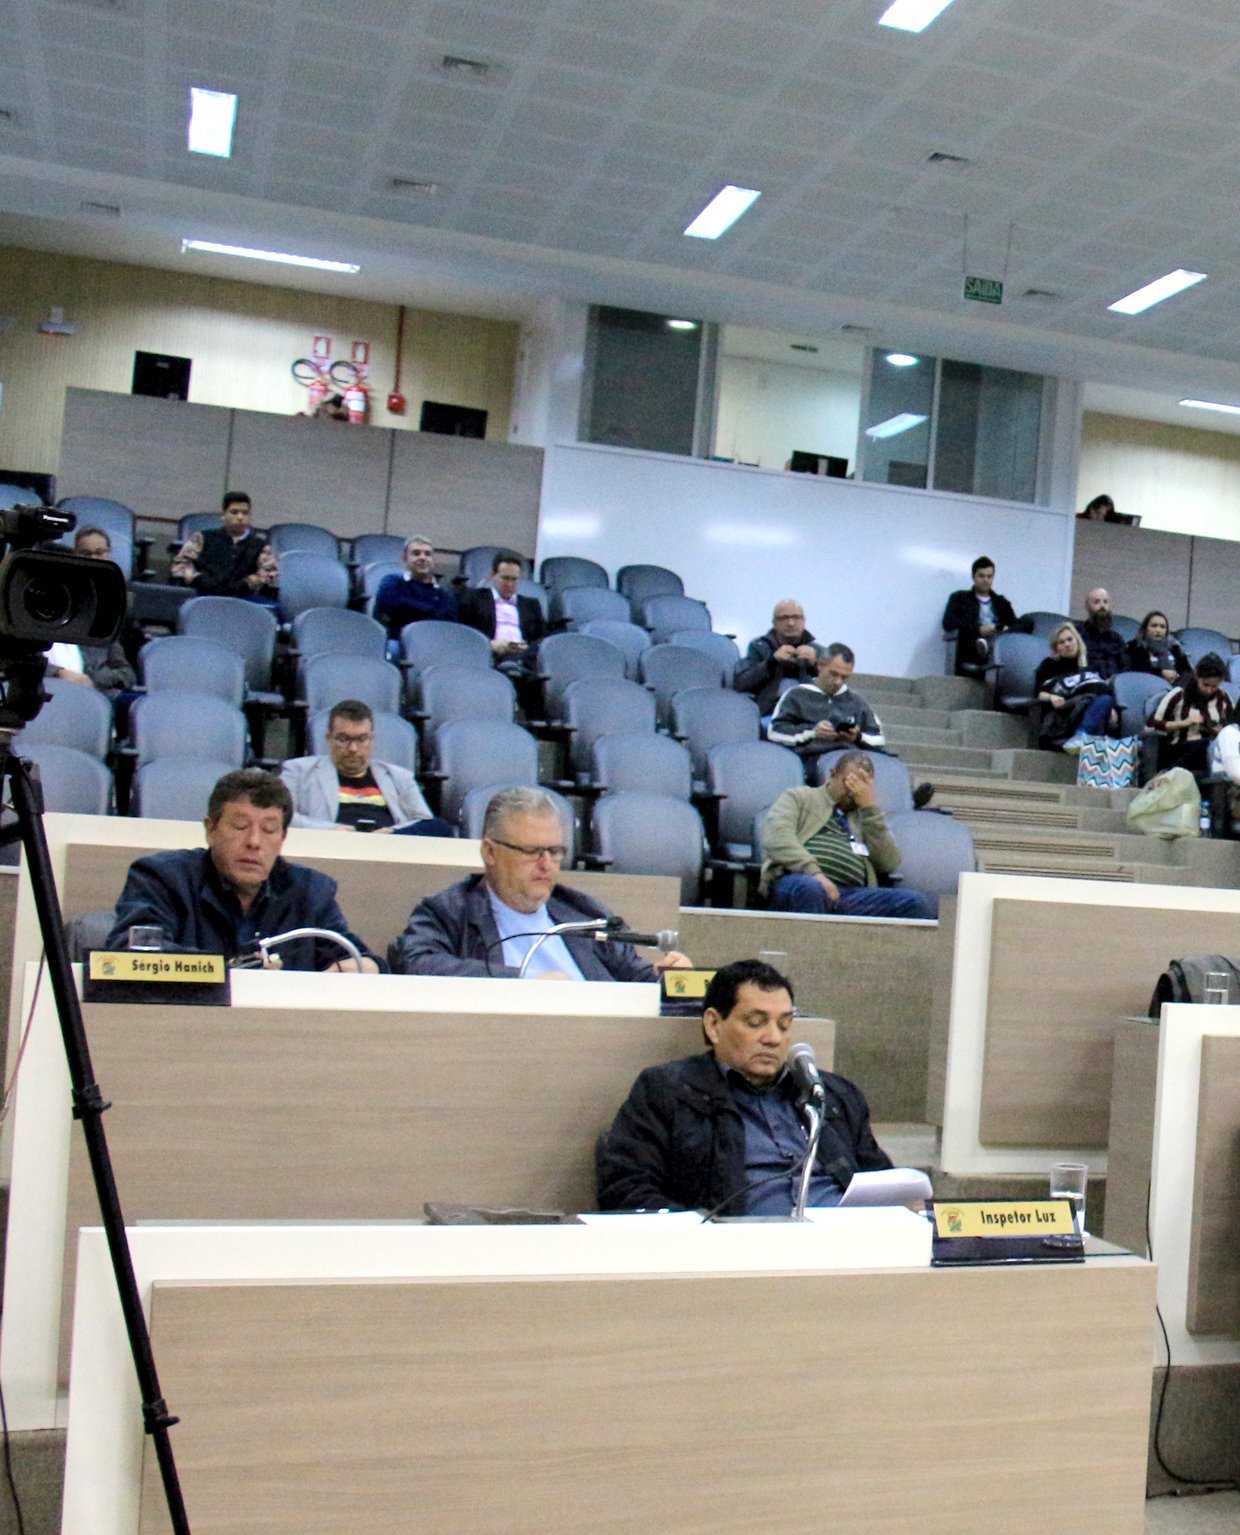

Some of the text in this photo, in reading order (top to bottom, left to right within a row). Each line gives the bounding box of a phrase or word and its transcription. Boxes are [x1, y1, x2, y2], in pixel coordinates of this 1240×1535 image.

[132, 958, 214, 975] Sérgio Hanich
[980, 1209, 1056, 1228] Inspetor Luz
